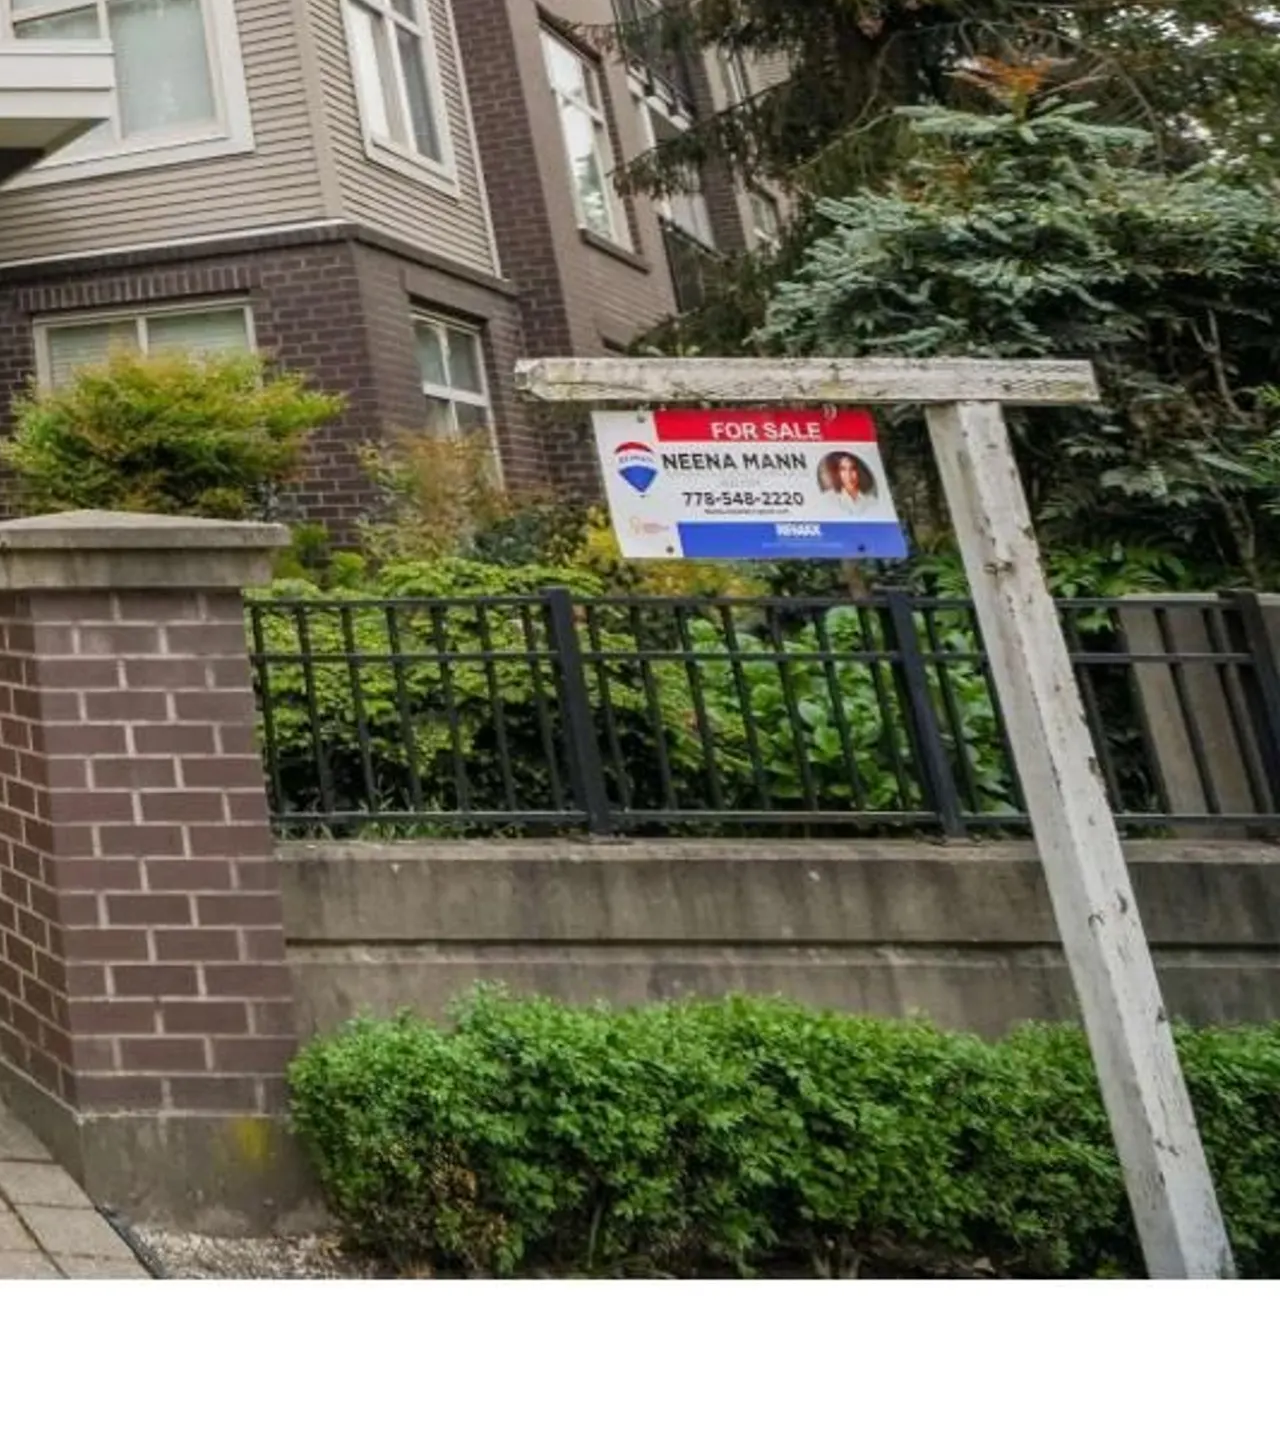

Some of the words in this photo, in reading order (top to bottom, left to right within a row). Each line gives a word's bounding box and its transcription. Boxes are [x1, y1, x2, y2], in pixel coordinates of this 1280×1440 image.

[710, 422, 758, 440] FOR
[762, 422, 822, 441] SALE
[661, 453, 738, 470] NEENA
[741, 453, 808, 470] MANN
[682, 491, 805, 507] 778-548-2220
